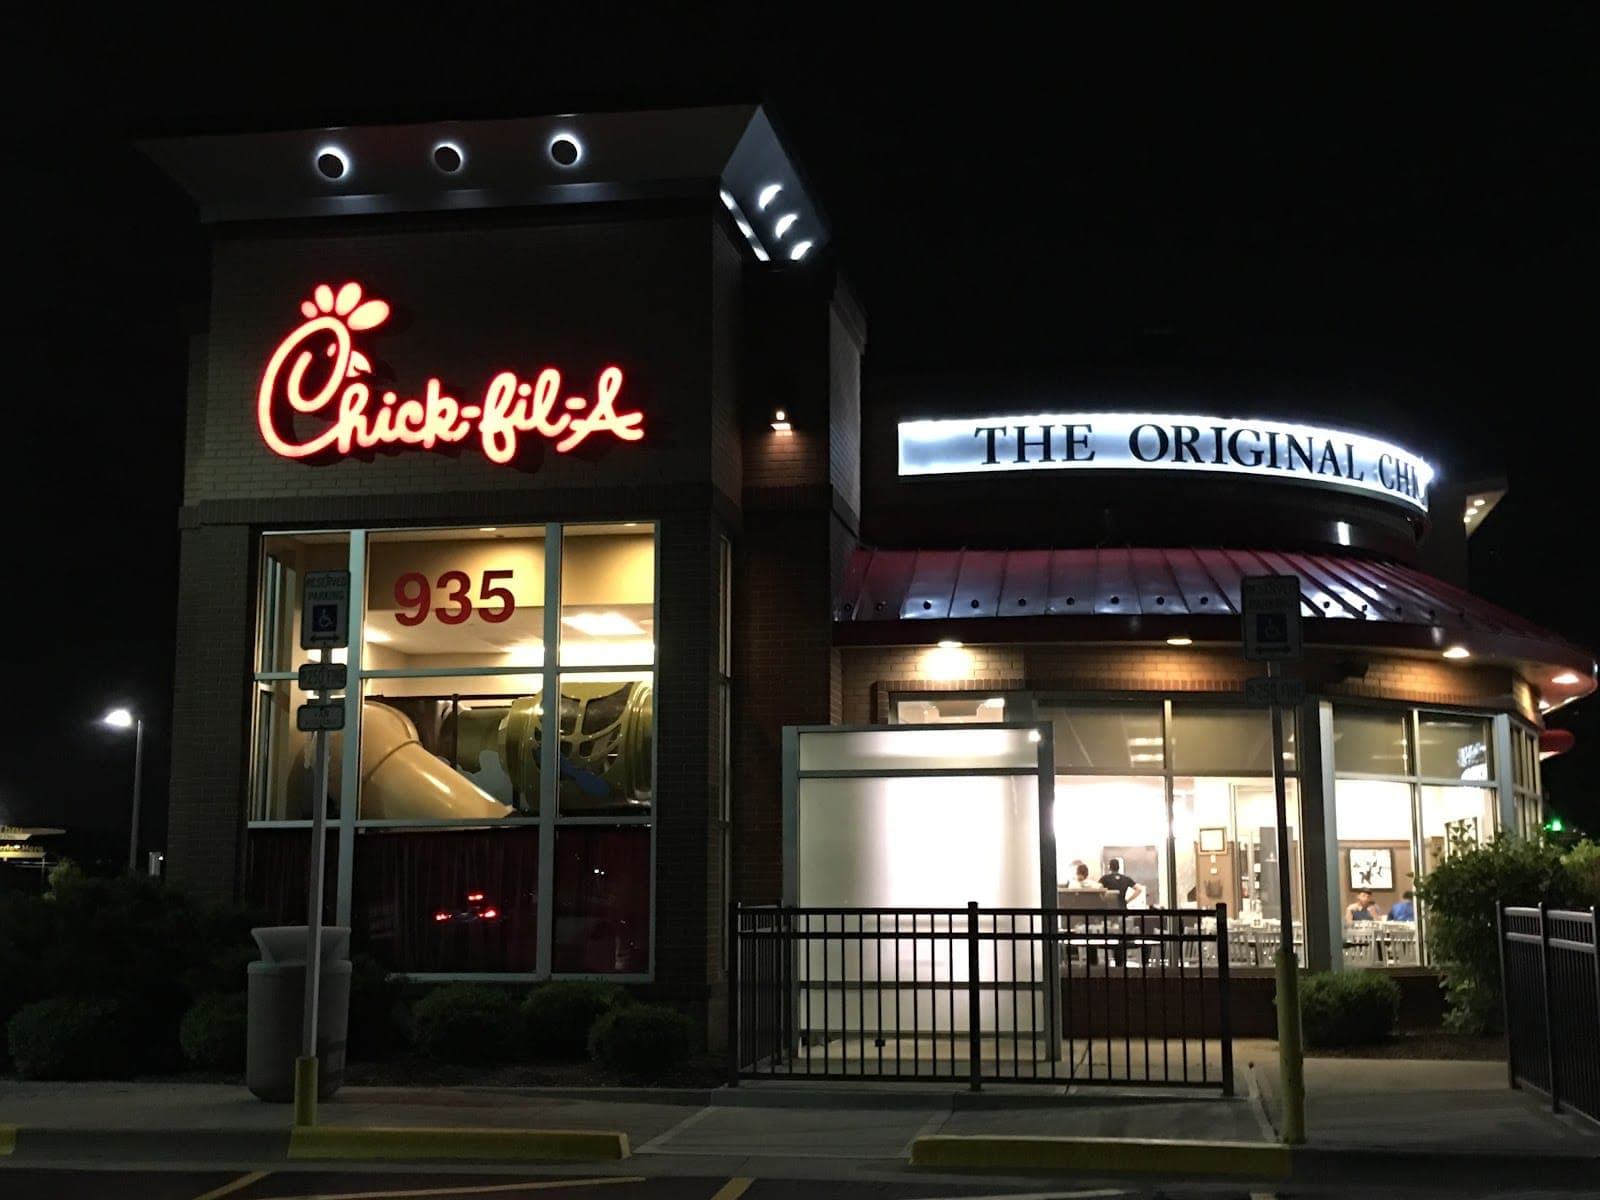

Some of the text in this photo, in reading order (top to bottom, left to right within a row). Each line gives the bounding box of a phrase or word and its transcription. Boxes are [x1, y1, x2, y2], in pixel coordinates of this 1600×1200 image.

[257, 282, 645, 464] Chick-fil-A
[974, 424, 1095, 464] THE
[1128, 423, 1365, 482] ORIGINAL
[394, 569, 515, 626] 935
